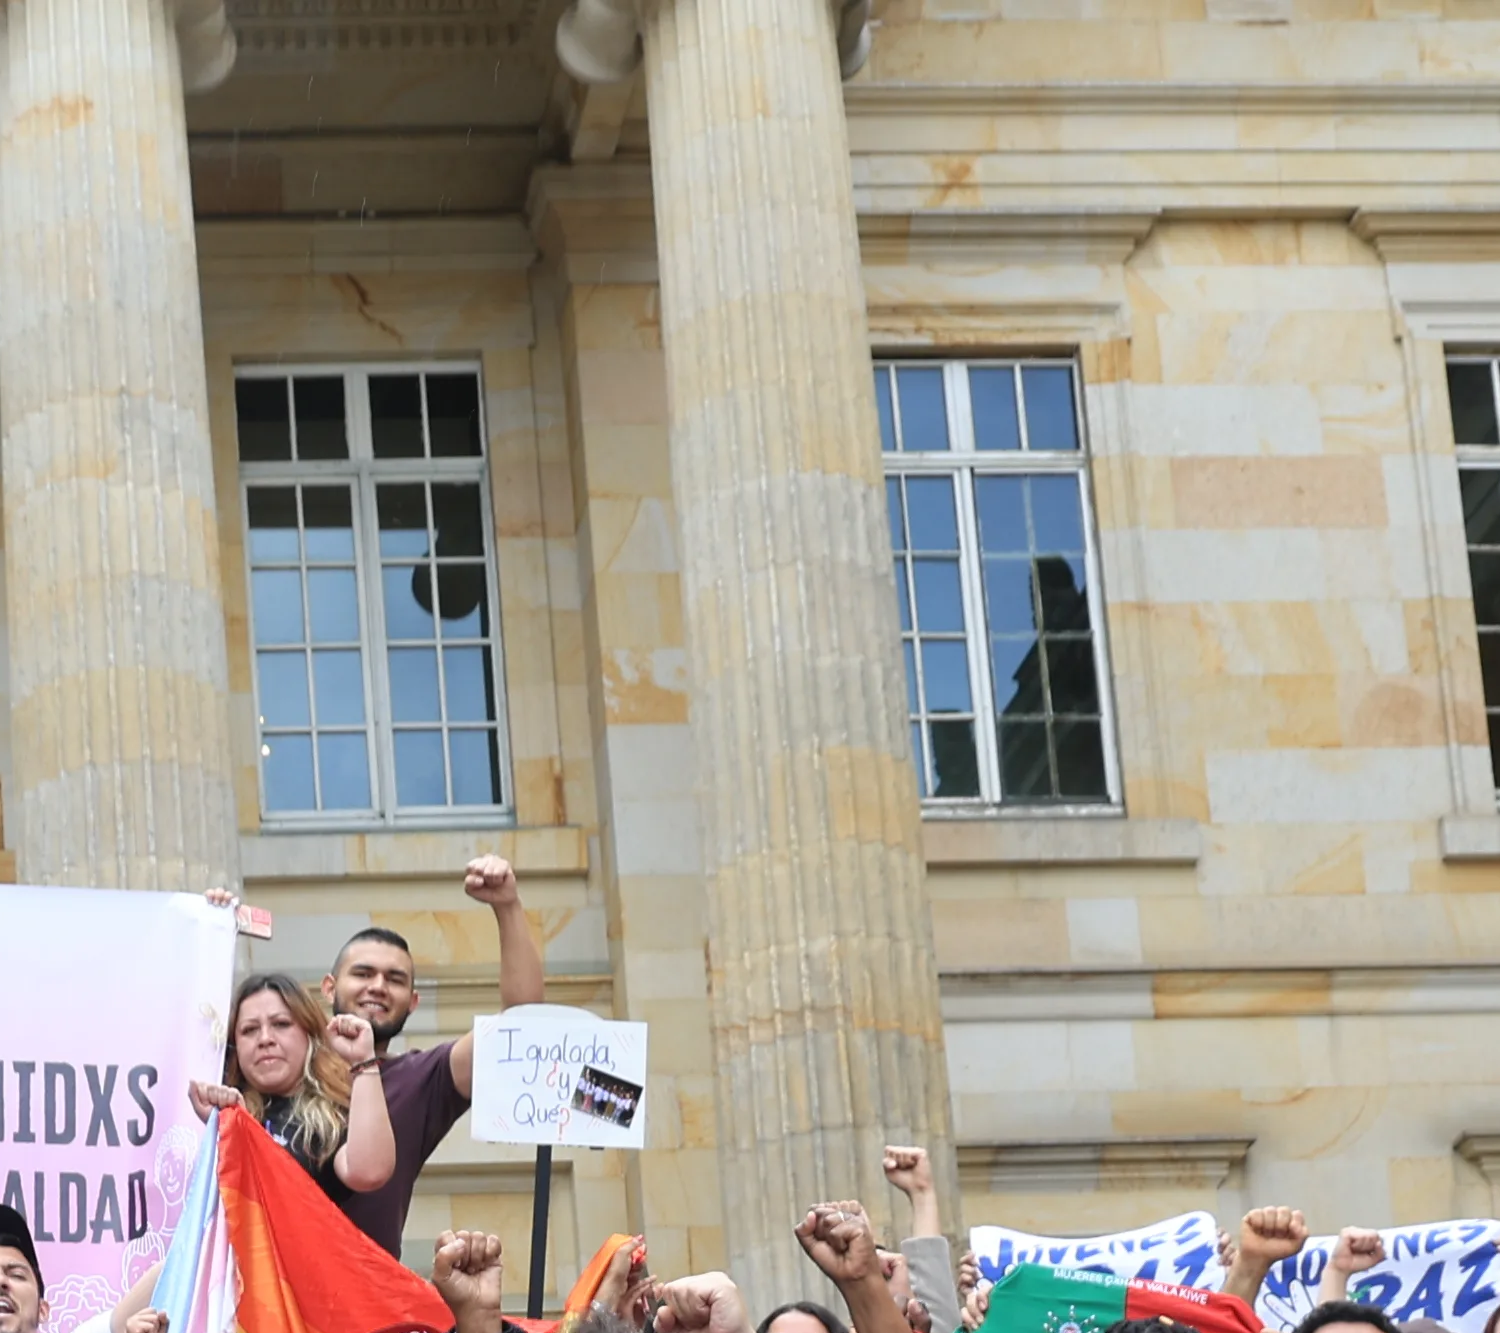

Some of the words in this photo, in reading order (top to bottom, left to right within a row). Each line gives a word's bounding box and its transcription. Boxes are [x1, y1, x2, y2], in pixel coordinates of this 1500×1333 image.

[497, 1028, 616, 1085] Igualada,
[1053, 1268, 1103, 1285] MUJERES
[1147, 1282, 1178, 1296] WALA
[1179, 1287, 1209, 1305] KIWE
[1352, 1241, 1500, 1321] PAZ
